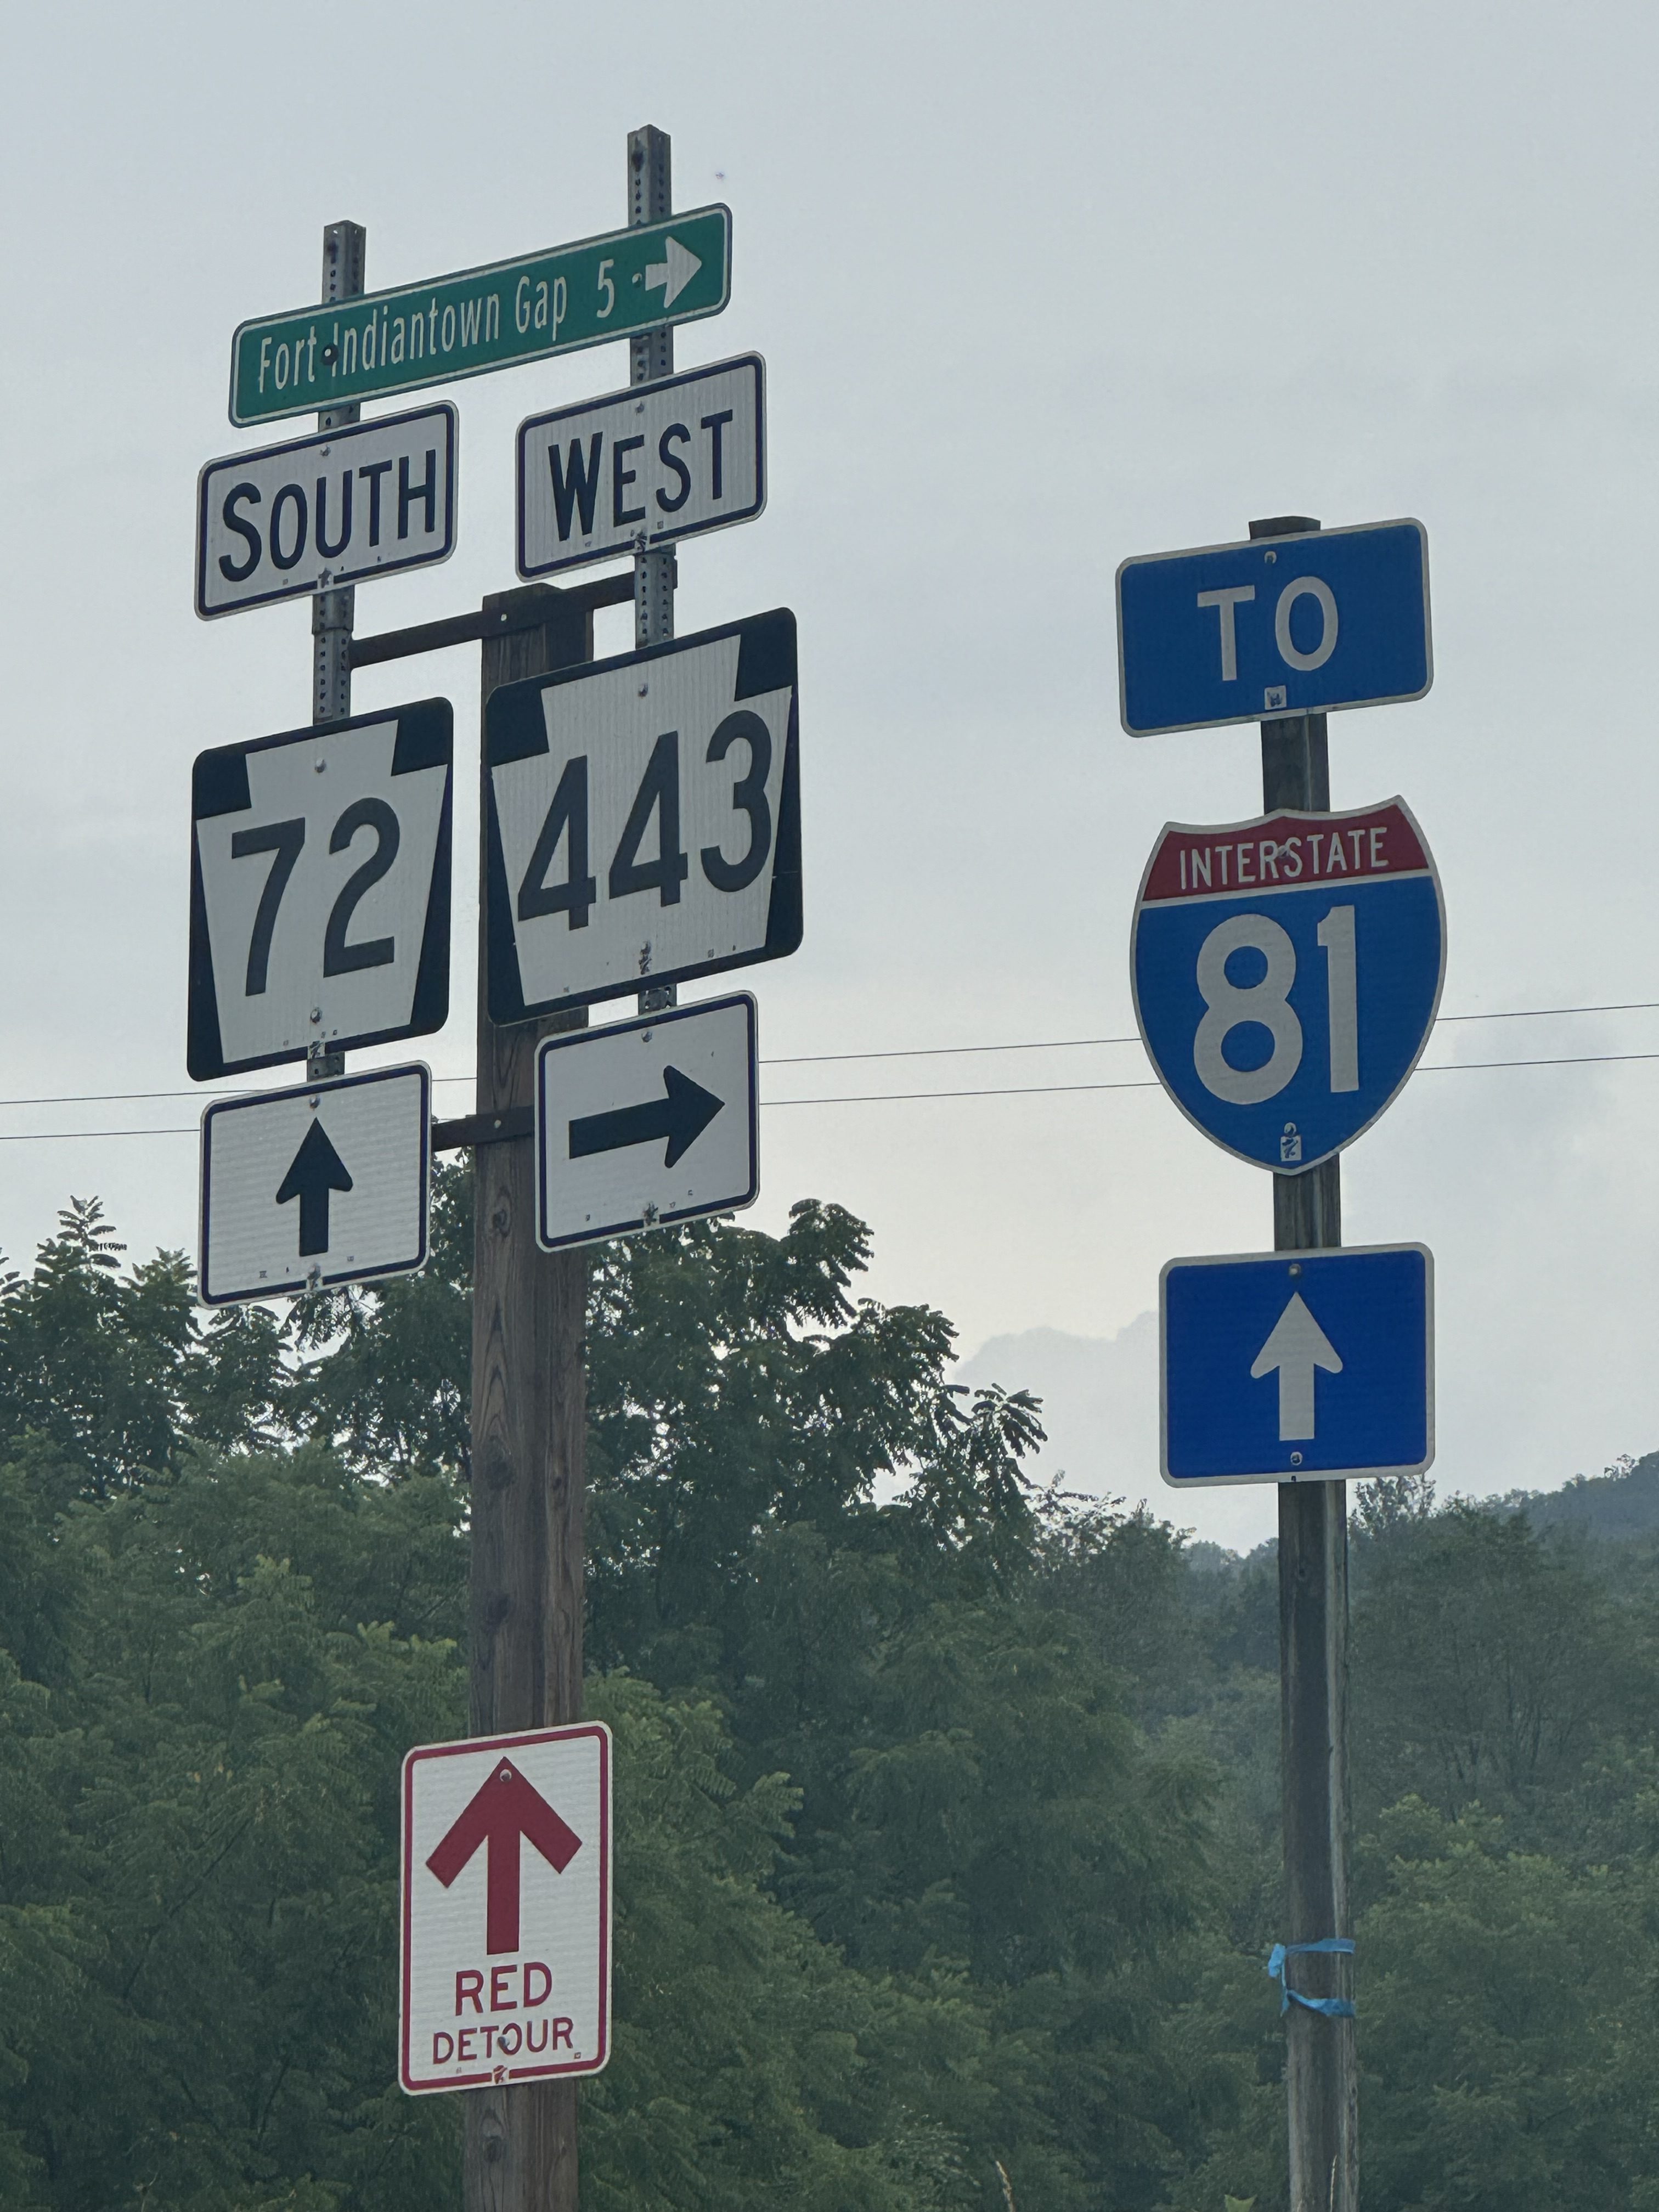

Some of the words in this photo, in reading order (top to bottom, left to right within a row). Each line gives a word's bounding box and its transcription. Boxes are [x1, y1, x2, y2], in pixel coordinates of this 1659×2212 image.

[259, 326, 315, 393] Fort
[332, 293, 499, 377] Indiantown
[516, 275, 567, 341] Gap
[596, 258, 614, 318] 5
[218, 449, 436, 583] SOUTH
[548, 410, 733, 541] WEST
[1197, 576, 1339, 681] TO
[517, 710, 772, 931] 443
[1180, 827, 1389, 889] INTERSTATE
[232, 797, 400, 996] 72
[1194, 905, 1359, 1105] 81
[432, 2017, 574, 2064] DETOUR
[455, 1962, 552, 2016] RED
